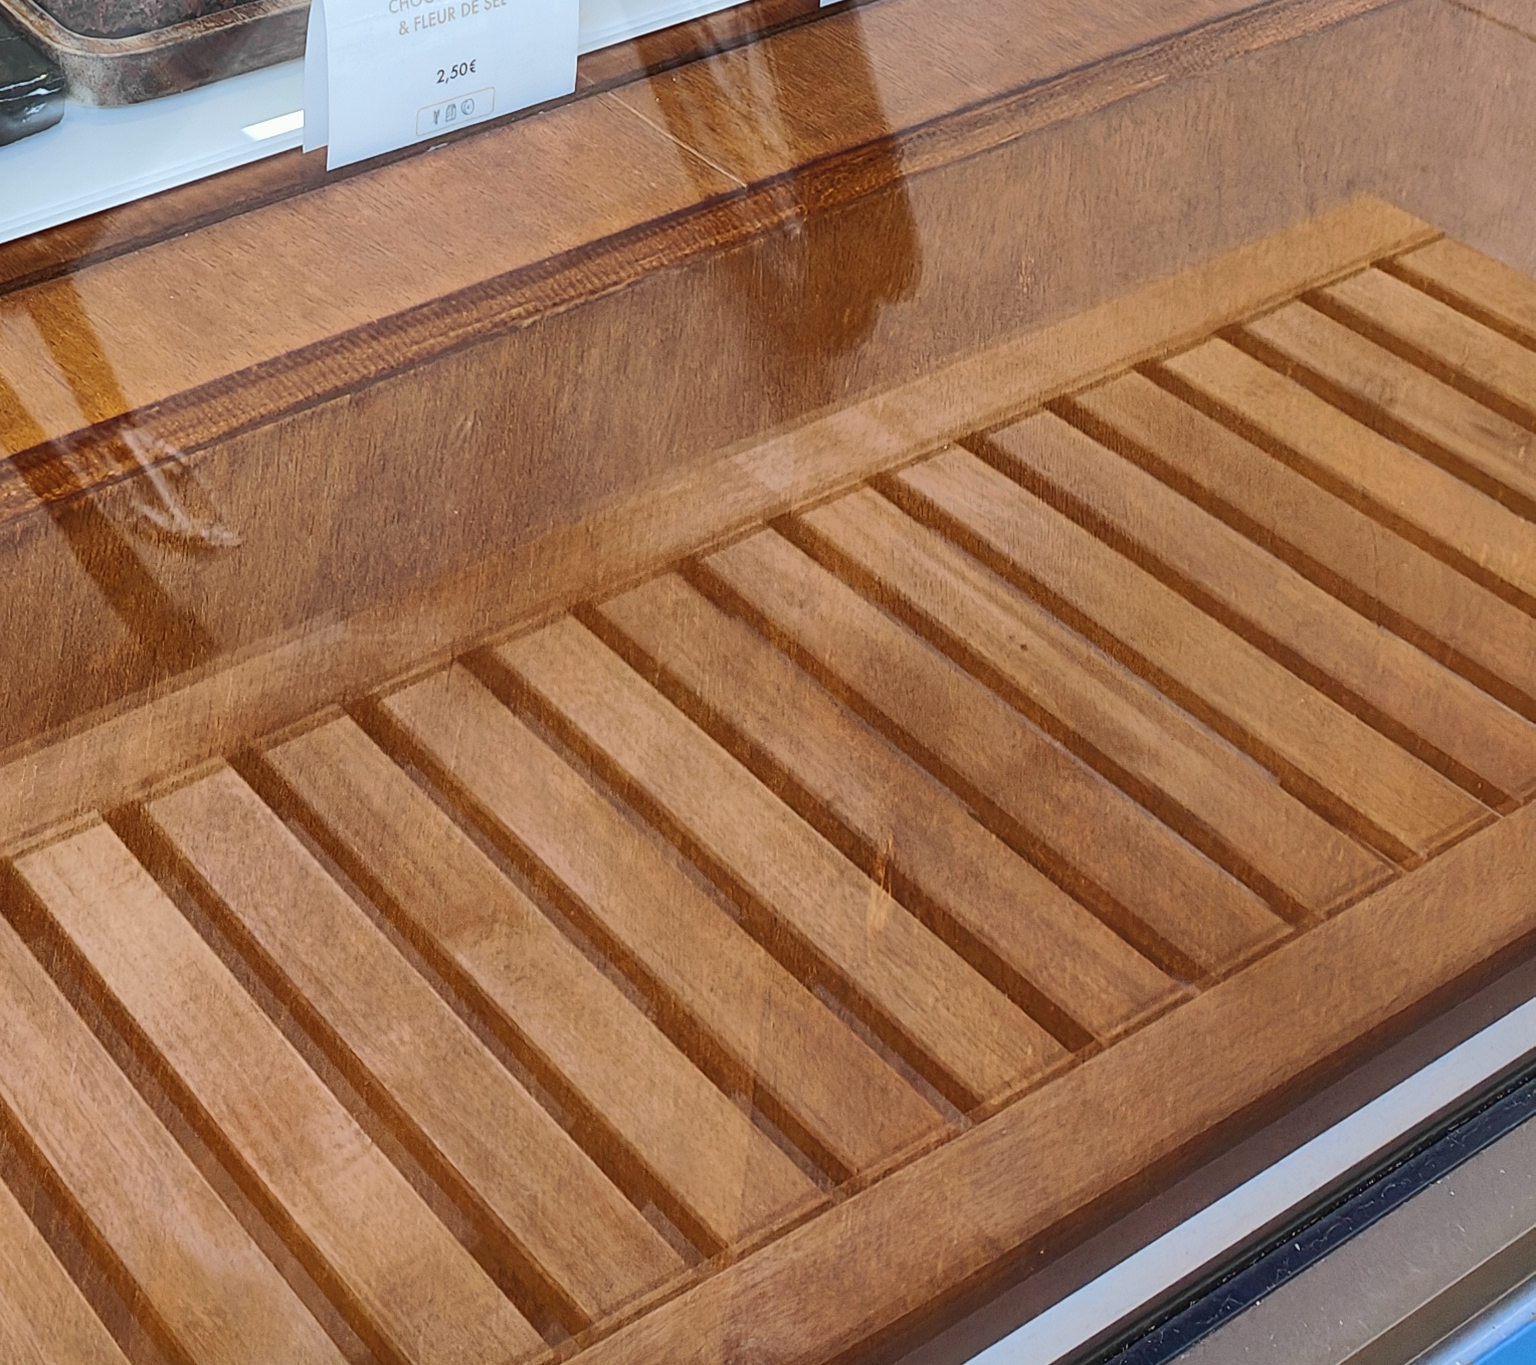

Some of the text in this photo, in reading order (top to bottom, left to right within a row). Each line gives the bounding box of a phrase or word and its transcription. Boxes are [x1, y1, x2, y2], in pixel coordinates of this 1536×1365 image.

[398, 21, 410, 35] &
[414, 6, 456, 32] FLEUR
[461, 0, 480, 18] DE
[436, 59, 477, 85] 2,50€
